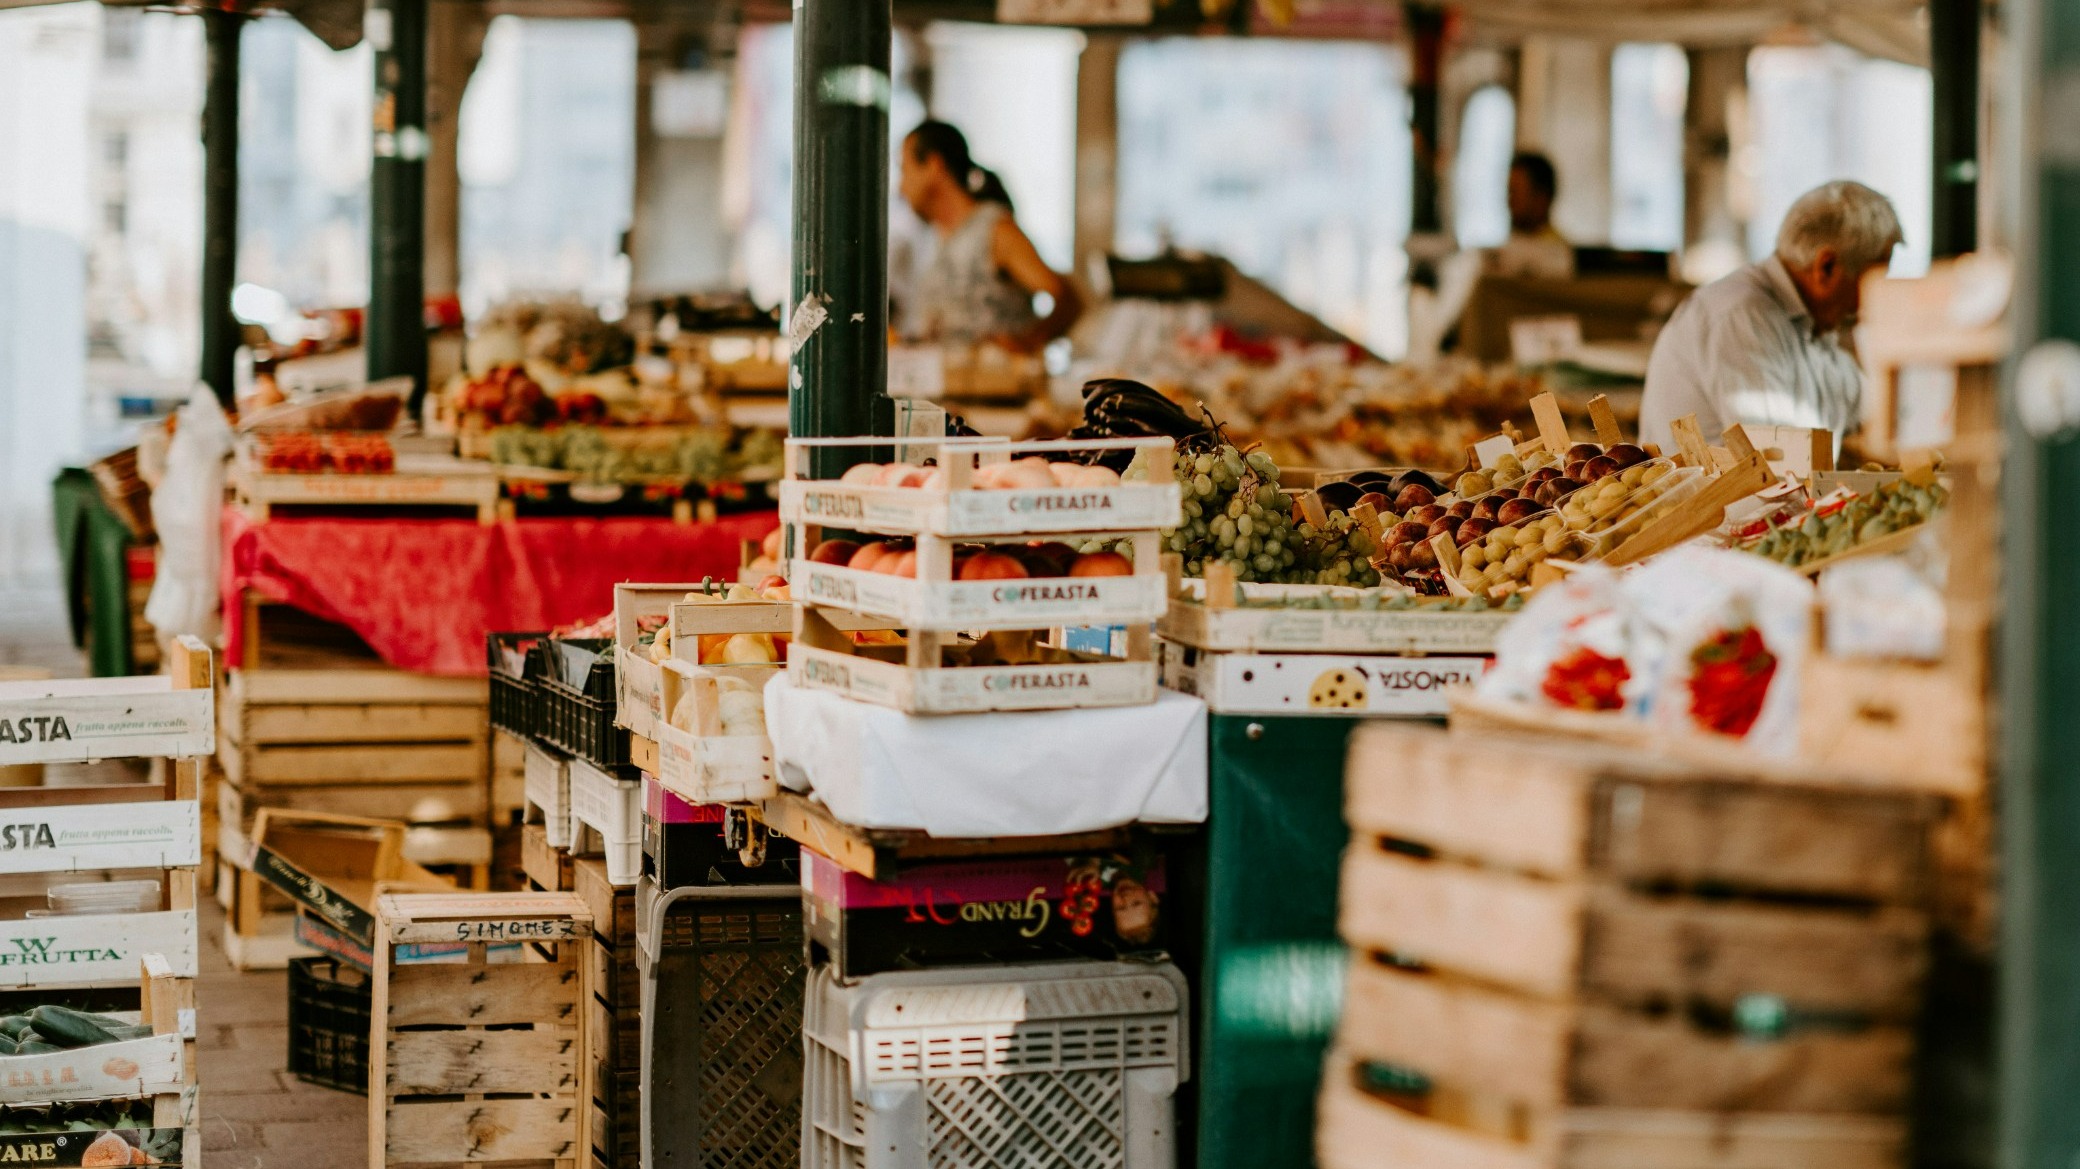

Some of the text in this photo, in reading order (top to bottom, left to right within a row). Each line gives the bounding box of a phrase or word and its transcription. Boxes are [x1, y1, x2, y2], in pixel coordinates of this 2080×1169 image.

[1009, 494, 1112, 511] COFERASTA
[993, 584, 1099, 602] COFERASTA
[983, 673, 1090, 691] COFERASTA
[0, 823, 56, 850] STA
[10, 937, 58, 954] W
[0, 948, 122, 966] FRUTTA
[0, 1143, 57, 1162] ARE
